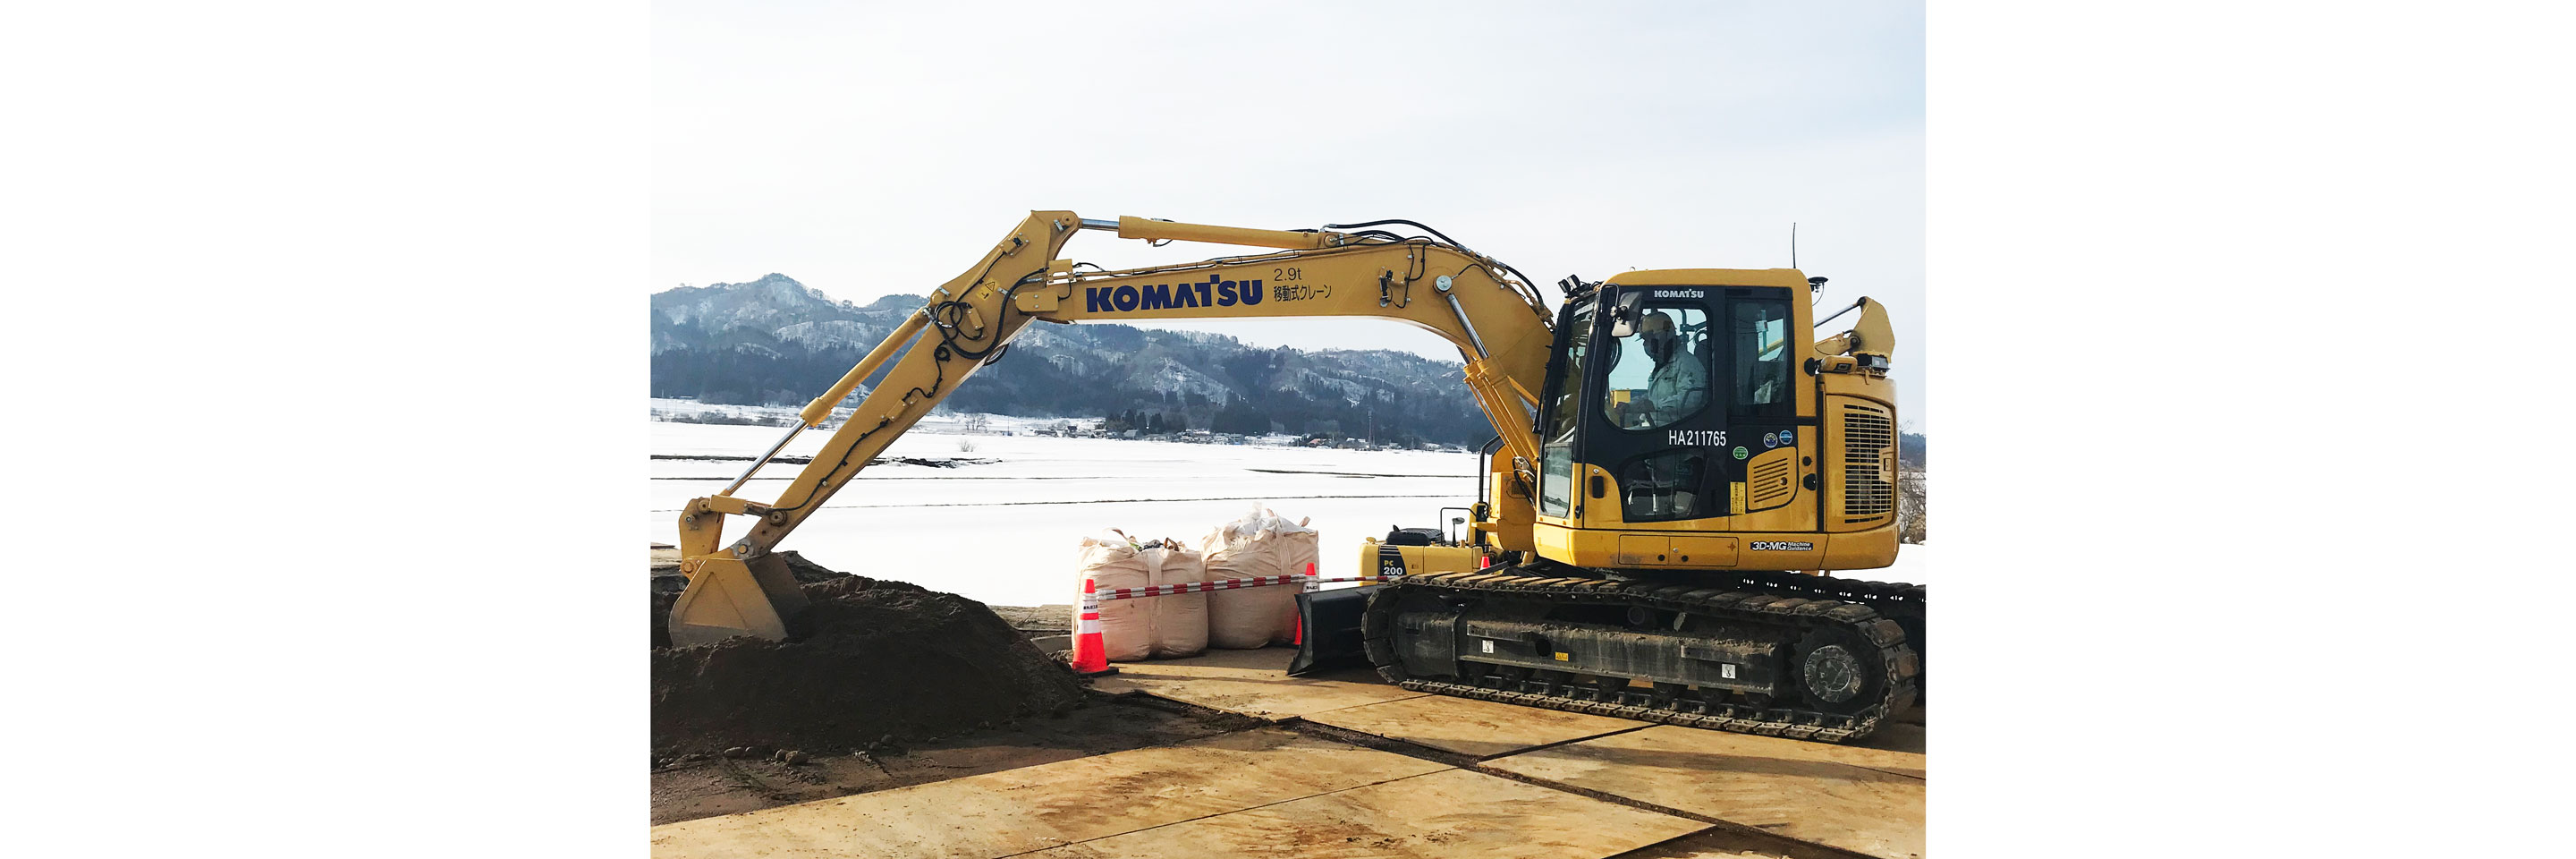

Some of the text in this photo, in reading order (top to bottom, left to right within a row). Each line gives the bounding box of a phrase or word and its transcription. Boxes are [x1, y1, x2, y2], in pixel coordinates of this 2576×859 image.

[1274, 268, 1301, 281] 2.9t
[1086, 274, 1263, 312] KOMATSU
[1274, 284, 1332, 302] 移動式クレーン
[1654, 288, 1704, 298] KOMATSU
[1668, 430, 1726, 447] HA211765
[1752, 541, 1787, 550] 3D-MG
[1384, 566, 1402, 574] 200
